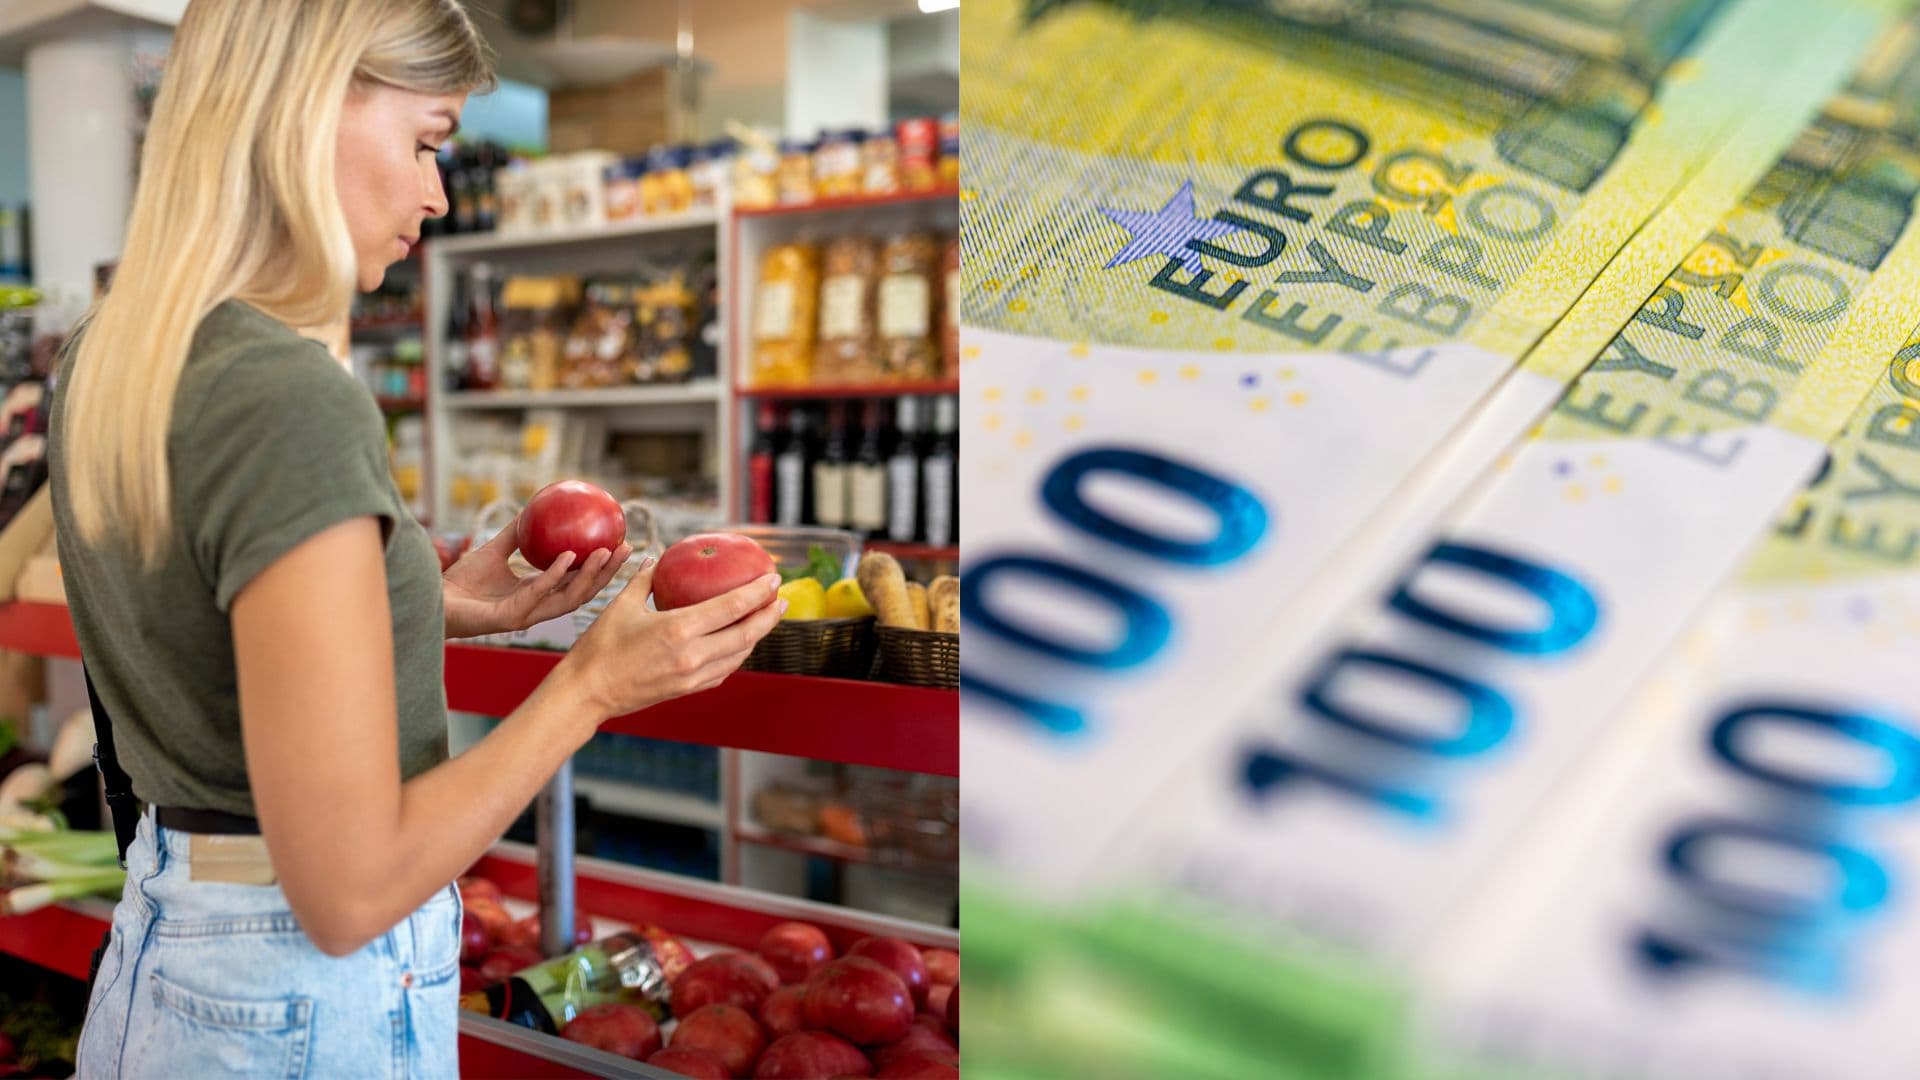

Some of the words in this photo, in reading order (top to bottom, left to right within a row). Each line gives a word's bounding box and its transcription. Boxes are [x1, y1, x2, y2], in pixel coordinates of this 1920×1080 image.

[1148, 119, 1370, 311] EURO
[1243, 541, 1600, 818] 100
[1636, 704, 1920, 994] 100
